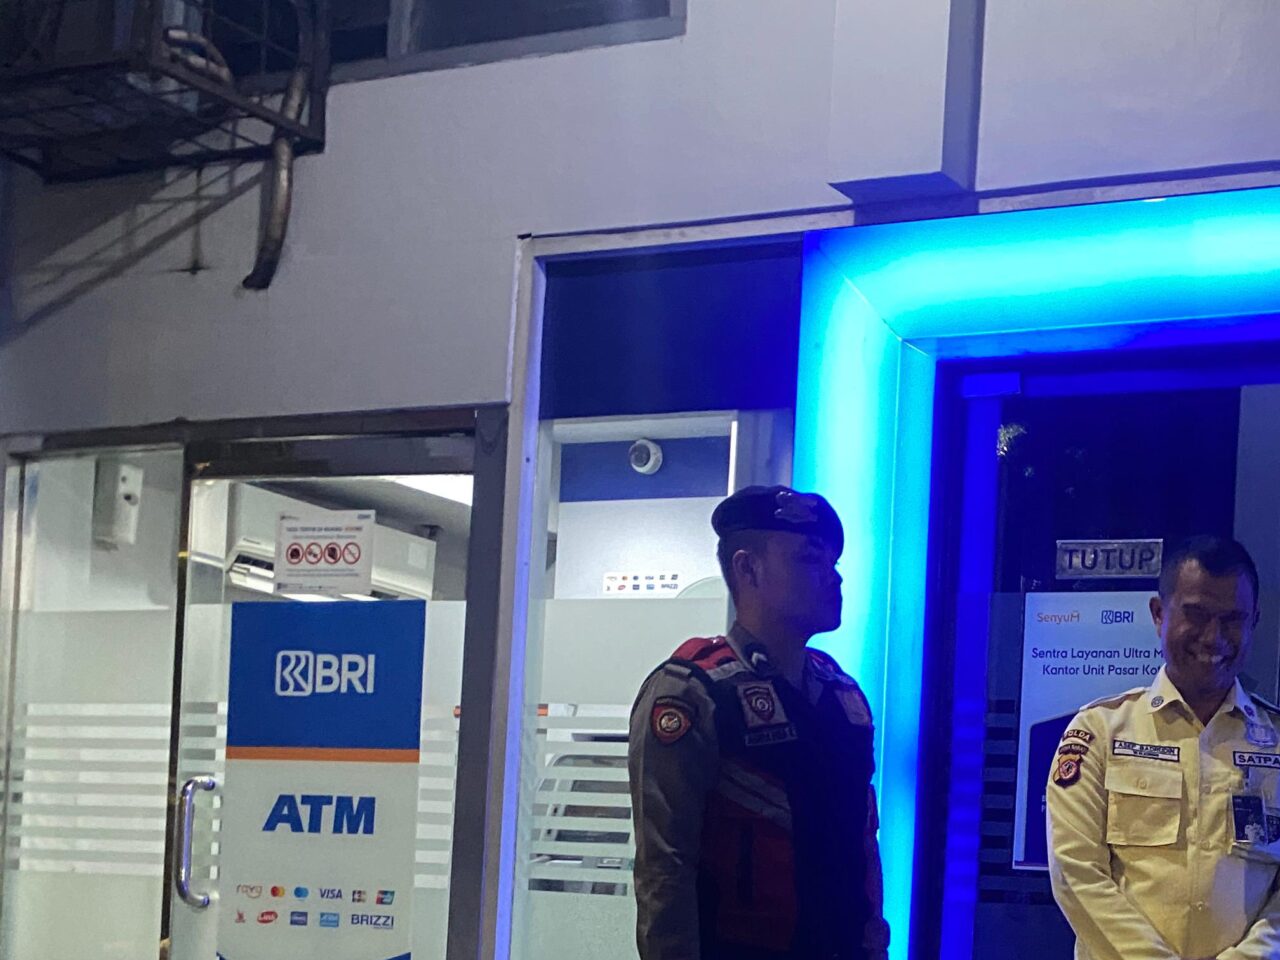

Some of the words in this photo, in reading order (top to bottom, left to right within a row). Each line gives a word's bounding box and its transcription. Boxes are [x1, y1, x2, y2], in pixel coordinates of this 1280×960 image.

[1062, 549, 1155, 570] TUTUP
[1115, 611, 1134, 624] BRI
[1031, 647, 1068, 659] Sentra
[1071, 648, 1120, 660] Layanan
[1123, 648, 1150, 659] Ultra
[315, 654, 376, 694] BRI
[1042, 664, 1079, 676] Kantor
[1083, 664, 1104, 675] Unit
[1108, 664, 1138, 676] Pasar
[262, 794, 376, 835] ATM
[320, 888, 342, 899] VISA
[351, 914, 394, 927] BRIZZI
